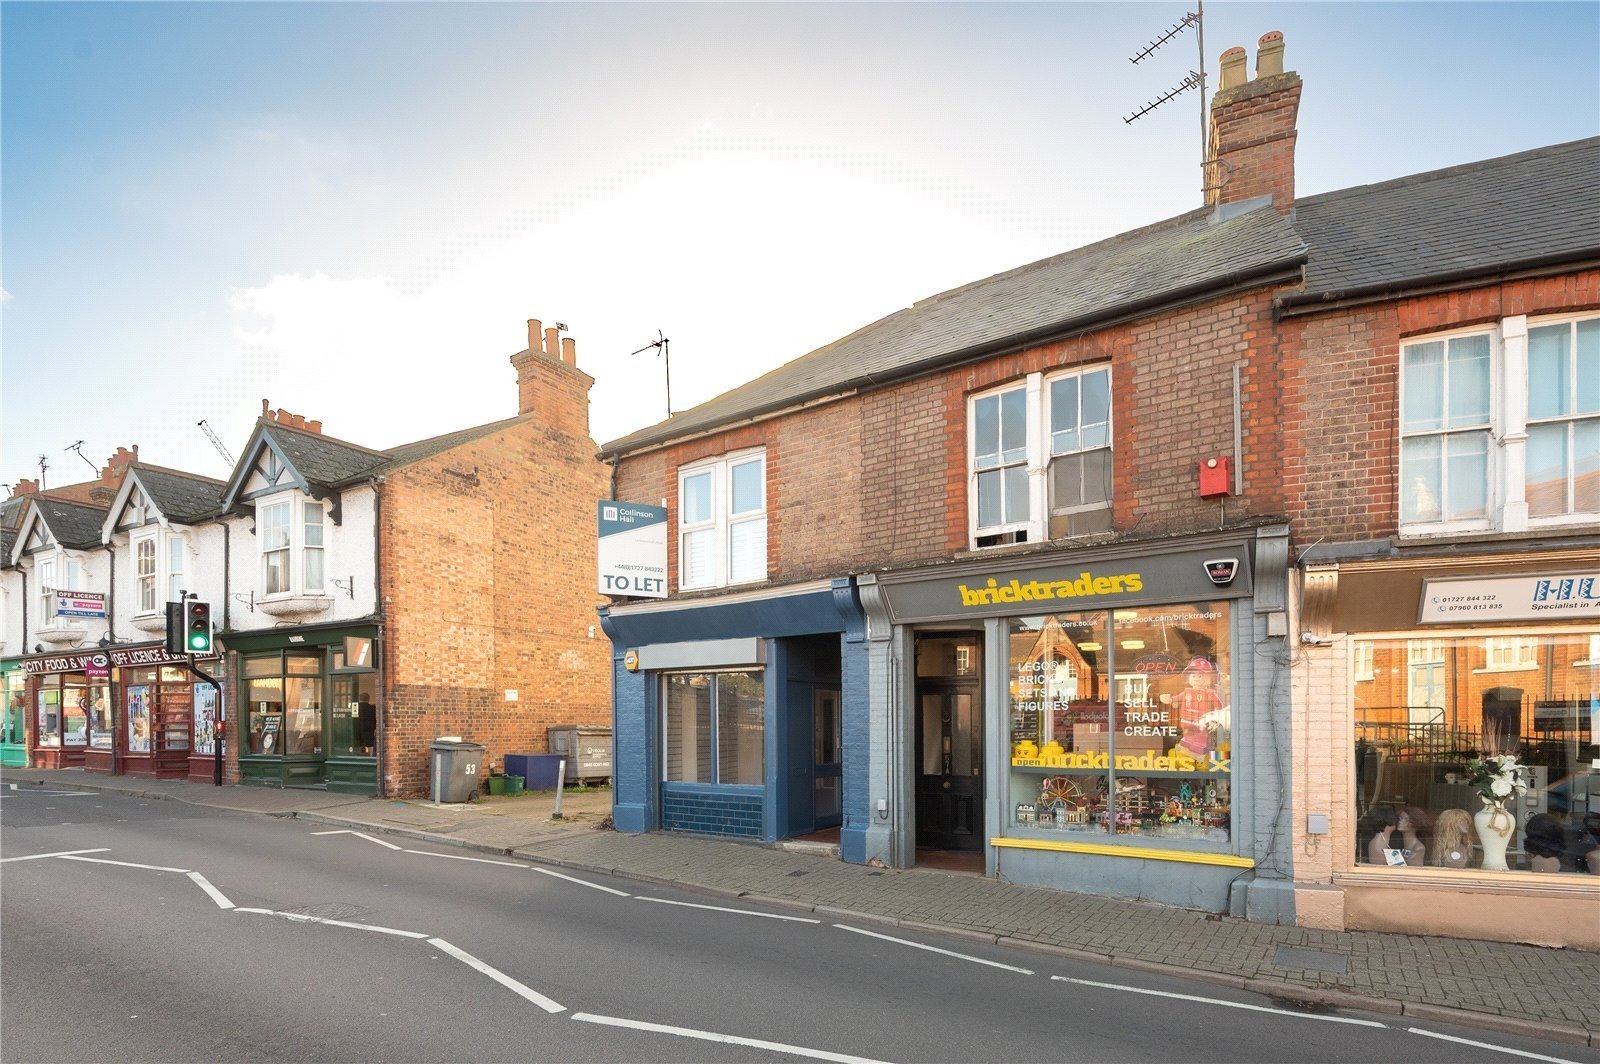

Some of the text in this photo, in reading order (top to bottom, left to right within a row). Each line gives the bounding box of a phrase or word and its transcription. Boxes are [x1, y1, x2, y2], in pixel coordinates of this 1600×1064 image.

[620, 508, 654, 518] Collinson
[620, 516, 634, 524] Hall
[603, 575, 663, 592] TO LET
[959, 572, 1143, 606] bricktraders
[1531, 602, 1578, 611] Specialist
[113, 653, 128, 665] OFF
[128, 650, 162, 663] LICENCE
[161, 649, 170, 660] &
[26, 661, 43, 672] CITY
[45, 659, 68, 670] FOOD
[69, 658, 78, 668] &
[1136, 662, 1177, 673] OPEN
[1018, 688, 1047, 698] SETS
[1124, 684, 1151, 694] BUY
[1018, 701, 1069, 711] FIGURES
[1124, 698, 1157, 708] SELL
[1124, 712, 1169, 722] TRADE
[1124, 726, 1177, 736] CREATE
[1017, 759, 1040, 767] open
[1048, 750, 1195, 771] bricktraders
[465, 764, 476, 775] 53
